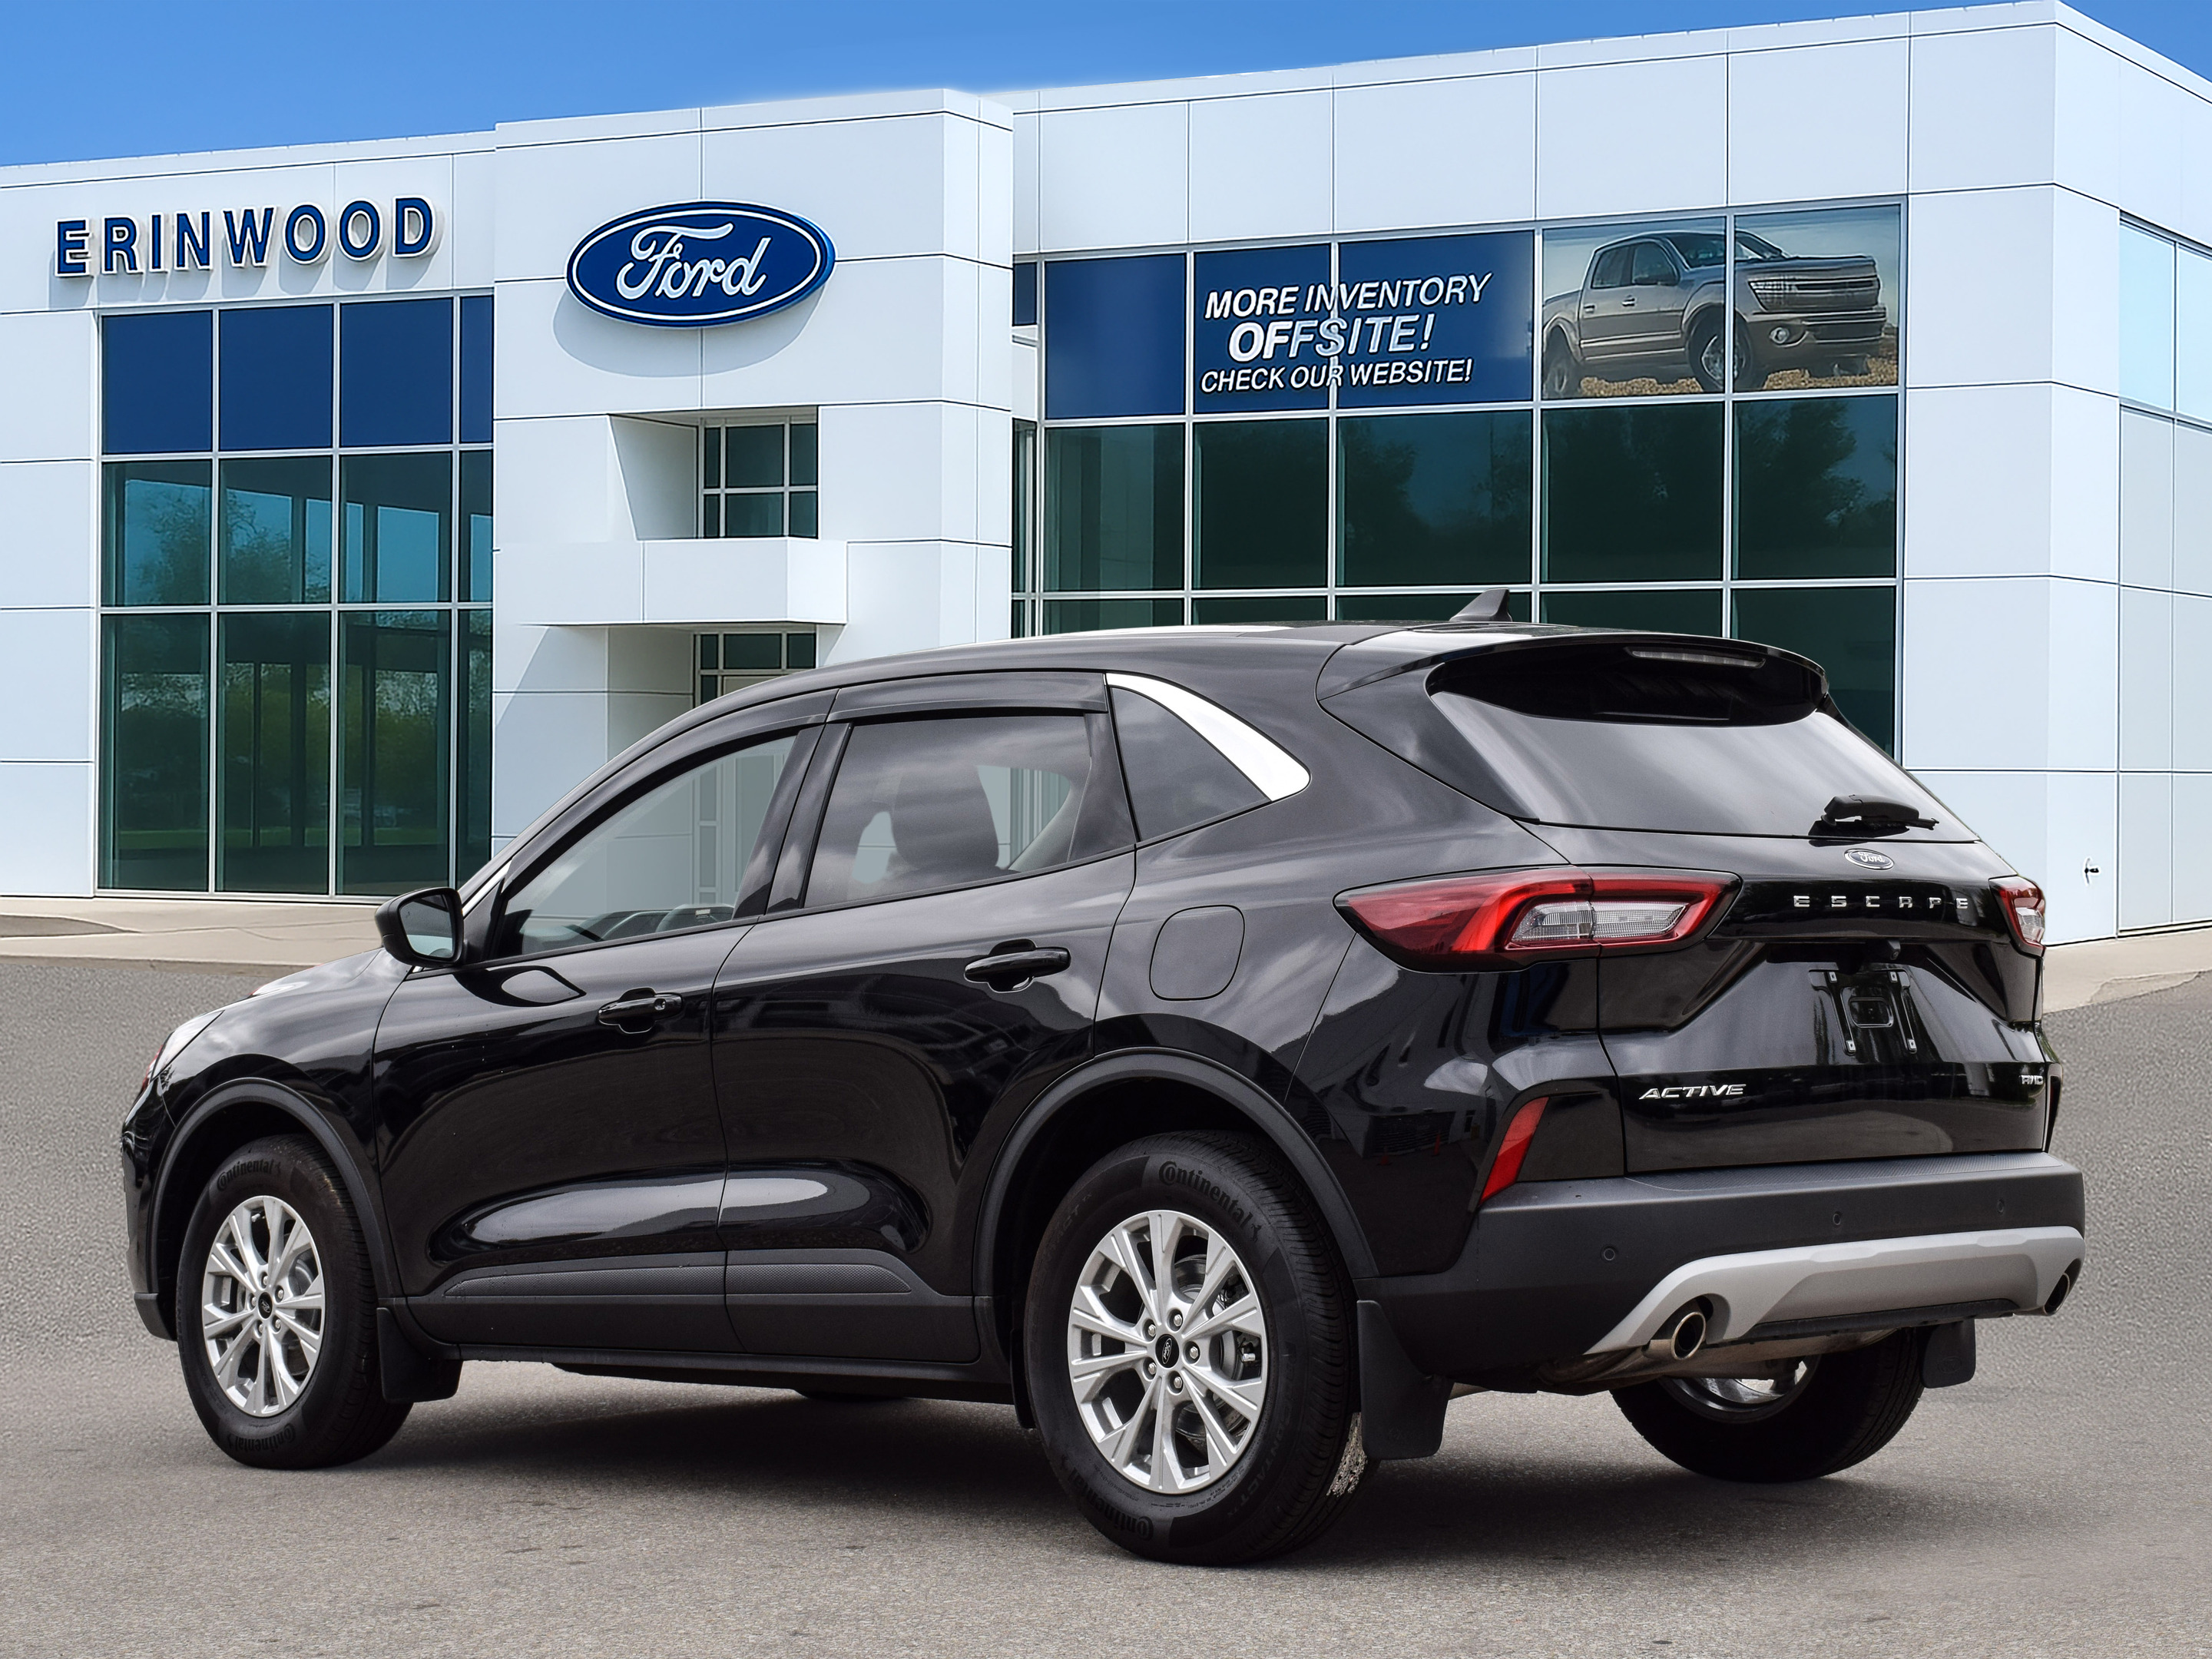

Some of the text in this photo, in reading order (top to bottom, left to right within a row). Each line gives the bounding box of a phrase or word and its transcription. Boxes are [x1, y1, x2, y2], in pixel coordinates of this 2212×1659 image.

[55, 196, 436, 277] ERINWOOD
[616, 222, 771, 300] Ford
[1204, 273, 1492, 319] MORE INVENTORY
[1228, 313, 1435, 362] OFFSITE!
[1201, 359, 1472, 392] CHECK OUR WEBSITE!
[1858, 851, 1886, 863] Ford
[1793, 896, 1968, 909] ESCAPE
[1639, 1084, 1747, 1099] ACTIVE
[217, 1159, 274, 1190] Continental
[1159, 1161, 1253, 1228] Continental
